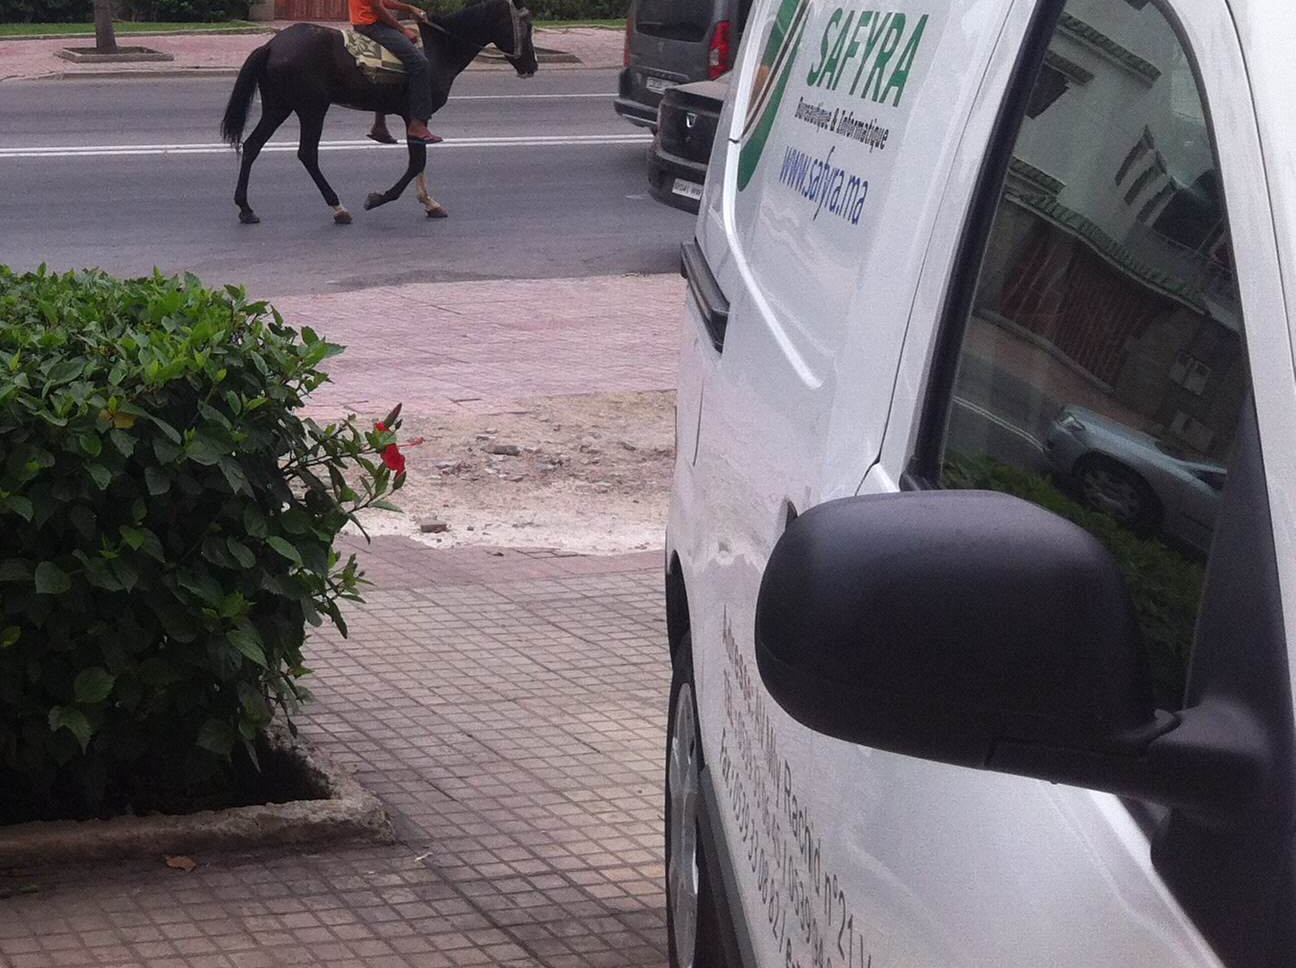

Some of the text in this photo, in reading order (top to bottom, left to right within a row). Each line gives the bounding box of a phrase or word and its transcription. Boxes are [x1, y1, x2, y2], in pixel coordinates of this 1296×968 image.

[806, 7, 929, 108] SAFYRA
[836, 110, 889, 153] Informatique
[779, 145, 868, 225] www.safyra.ma
[784, 759, 822, 899] Rachid
